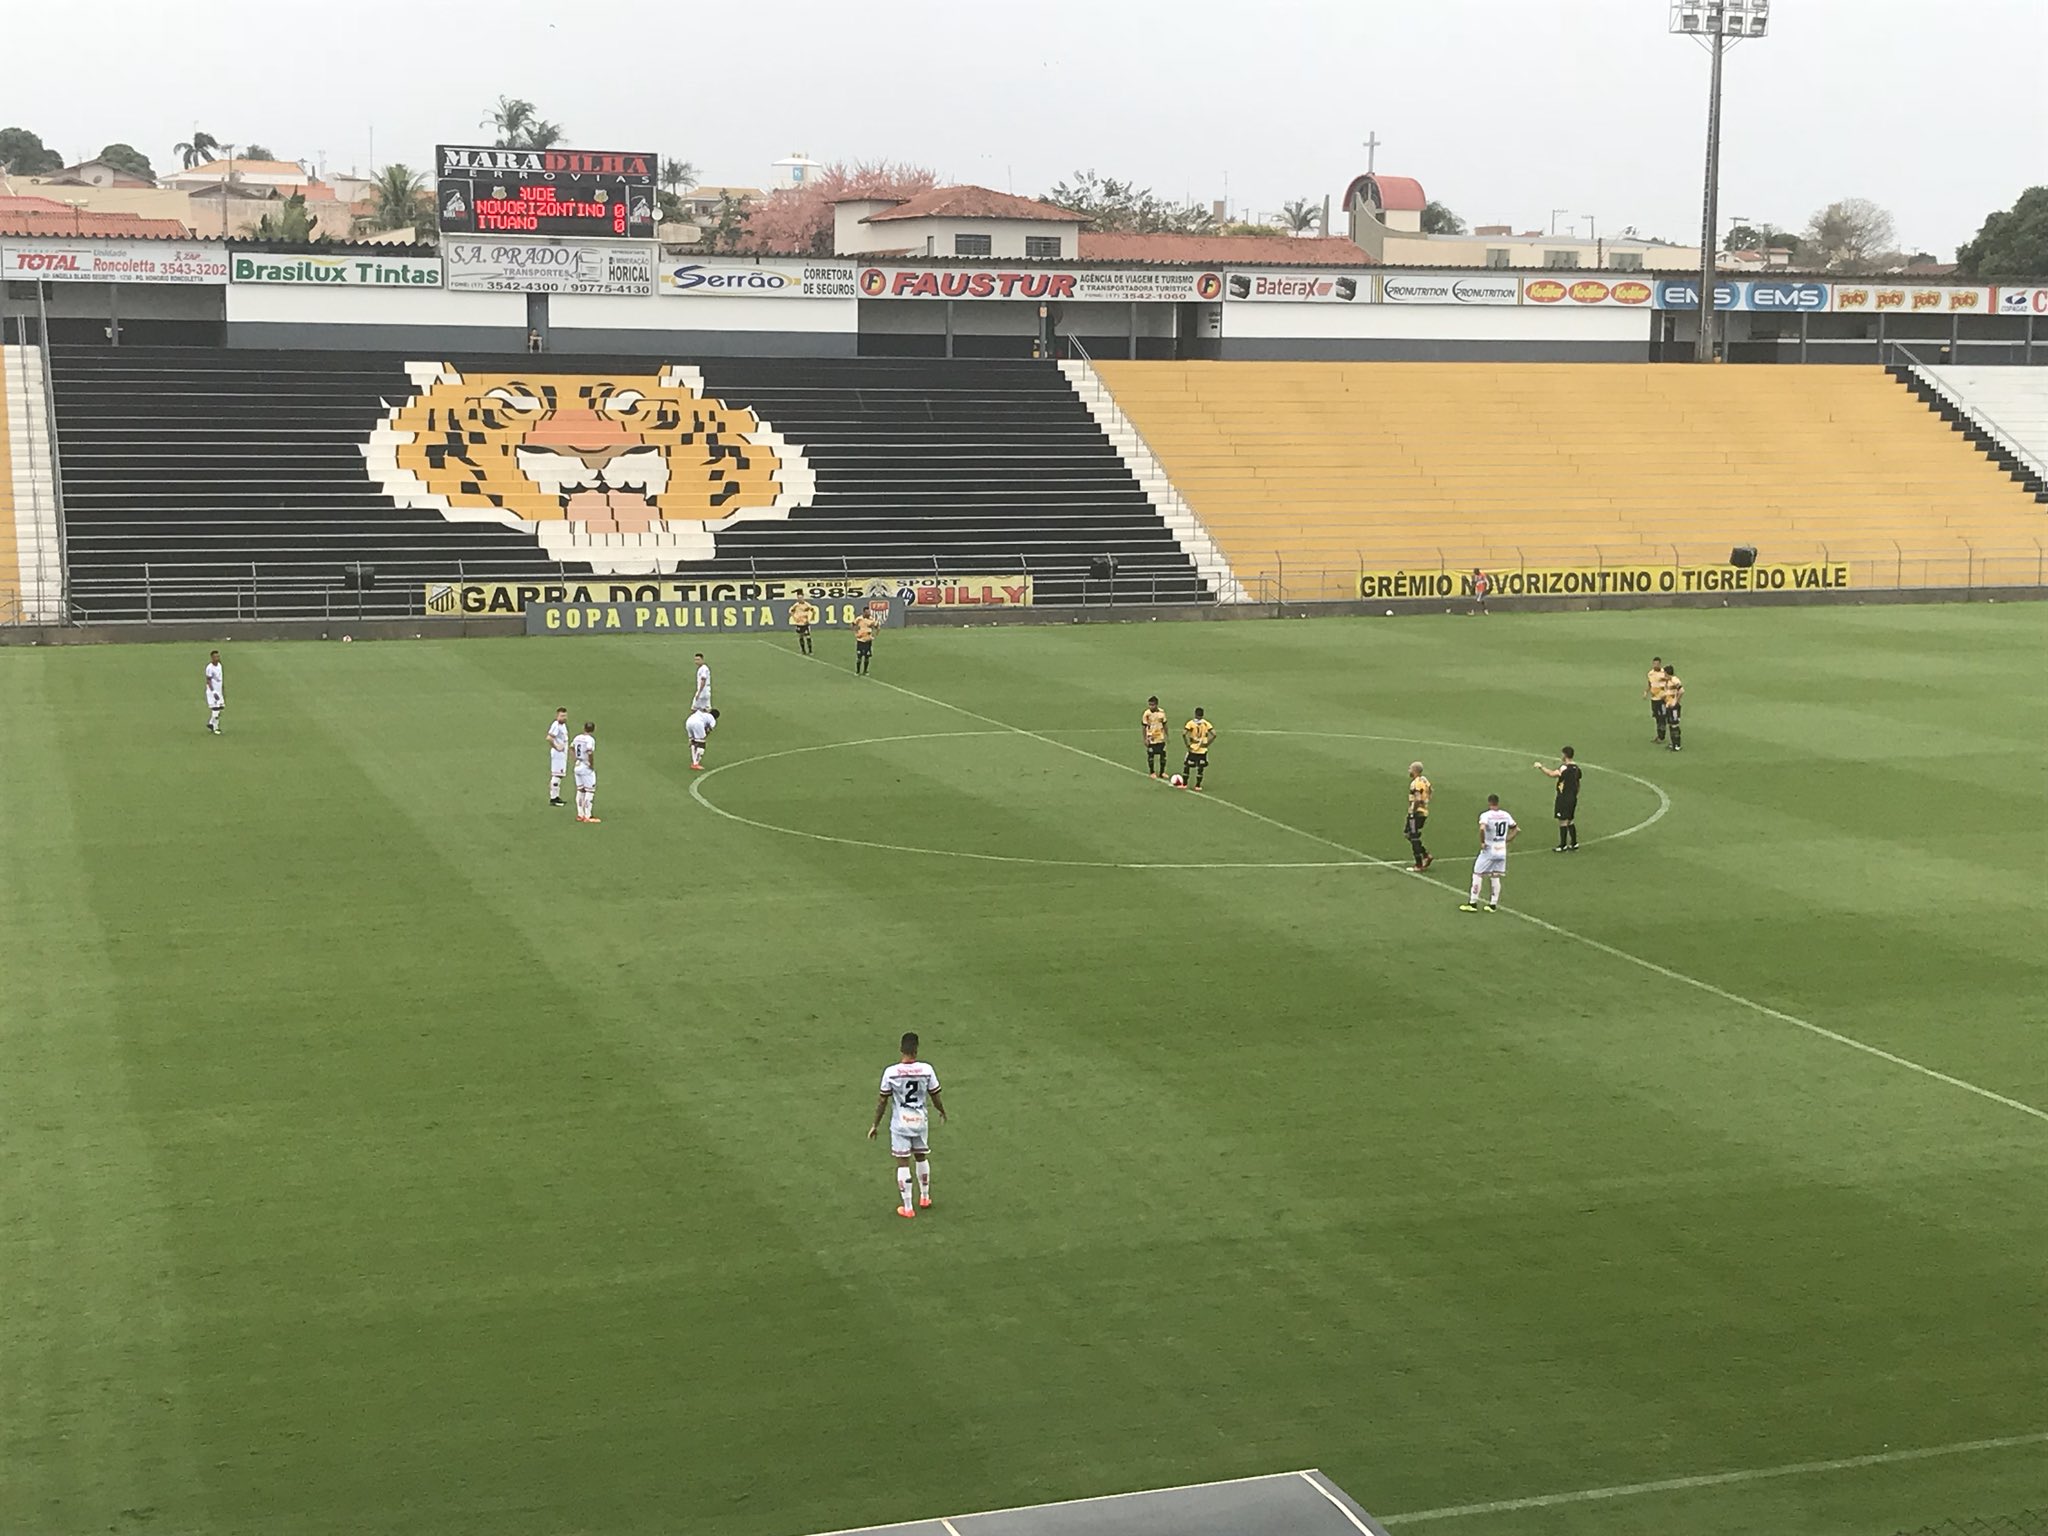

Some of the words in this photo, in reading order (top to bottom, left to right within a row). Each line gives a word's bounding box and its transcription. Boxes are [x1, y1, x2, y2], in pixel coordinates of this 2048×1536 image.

[444, 169, 650, 184] FERROVIAS
[477, 200, 605, 217] NOVORIZONTINO
[614, 204, 625, 217] 0
[479, 215, 537, 230] ITUANO
[614, 219, 625, 233] 0
[17, 254, 80, 270] TOTAL
[450, 245, 487, 265] S.A.
[491, 246, 570, 267] PRADO
[93, 258, 155, 273] Roncoletta
[160, 262, 227, 275] 3543-3202
[236, 259, 347, 282] Brasilux
[356, 263, 439, 284] Tintas
[503, 268, 569, 279] TRANSPORTES
[608, 266, 649, 282] HORICAL
[803, 268, 854, 281] CORRETORA
[673, 265, 784, 289] Serrão
[891, 271, 1077, 298] FAUSTUR
[1080, 274, 1112, 283] AGÊNCIA
[1114, 275, 1124, 283] DE
[1125, 275, 1153, 283] VIAGEM
[1162, 275, 1193, 284] TURISMO
[487, 282, 558, 291] 3542-4300
[571, 284, 649, 294] 99775-4130
[803, 283, 814, 294] DE
[816, 284, 855, 295] SEGUROS
[1754, 289, 1819, 305] EMS
[897, 579, 960, 587] SPORT
[1361, 571, 1452, 597] GRÊMIO
[1659, 571, 1675, 591] O
[1682, 570, 1748, 591] TIGRE
[1755, 569, 1786, 590] DO
[1792, 567, 1847, 588] VALE
[461, 585, 593, 613] GARRA
[674, 583, 785, 602] TIGRE
[917, 586, 1029, 604] BILLY
[546, 608, 621, 628] COPA
[636, 606, 774, 628] PAULISTA
[1494, 821, 1507, 837] 10
[905, 1081, 919, 1103] 2
